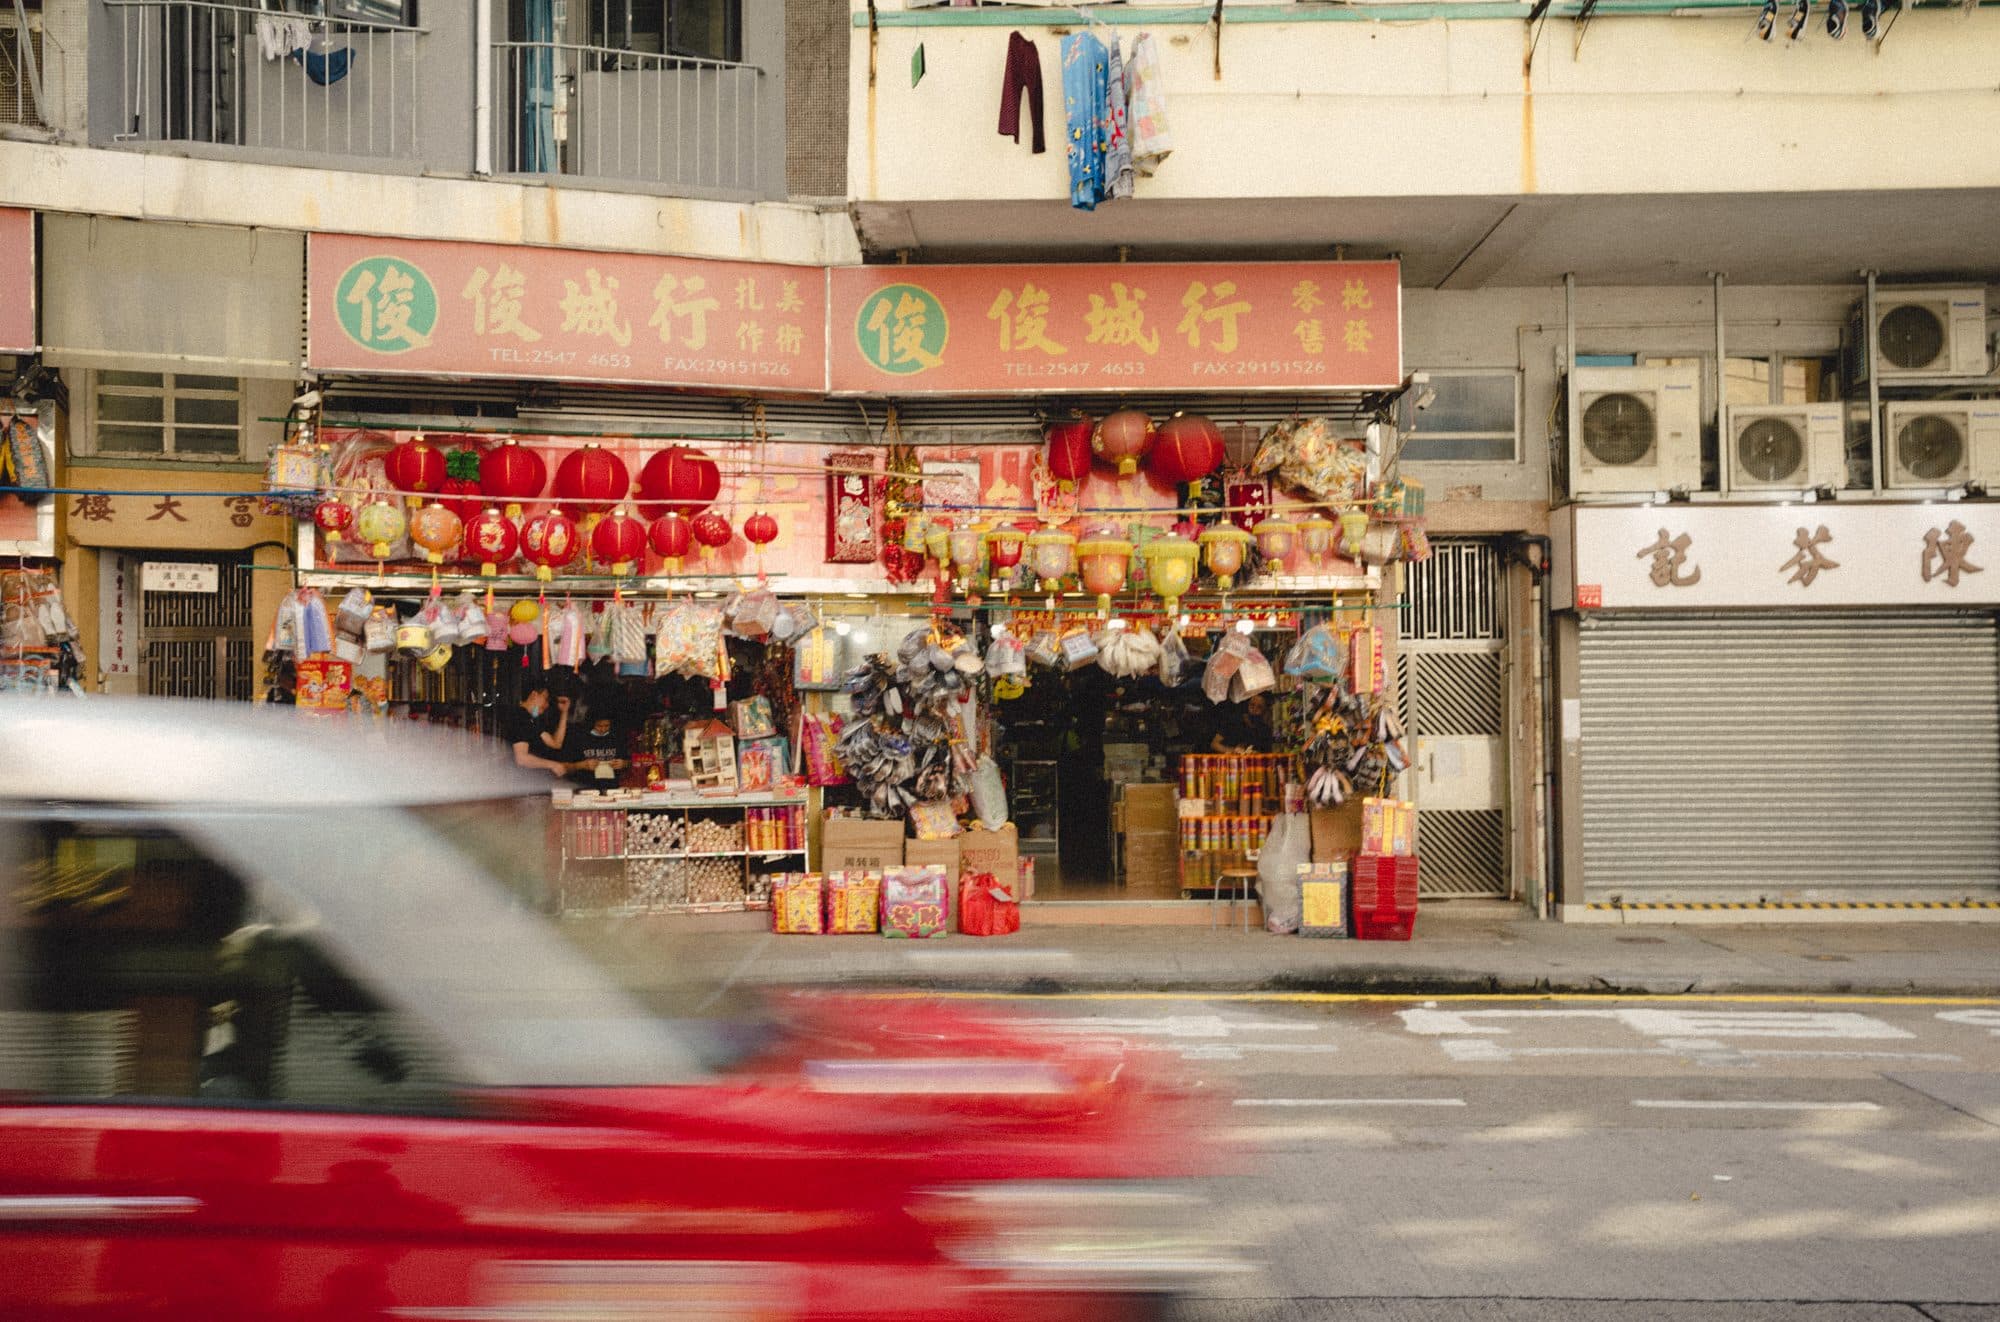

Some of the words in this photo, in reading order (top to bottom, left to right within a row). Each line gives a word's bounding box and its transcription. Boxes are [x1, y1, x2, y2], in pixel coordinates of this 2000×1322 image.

[346, 262, 434, 351] 俊
[461, 261, 721, 352] 俊城行
[866, 292, 945, 371] 俊
[987, 281, 1252, 356] 俊城行
[1101, 361, 1146, 376] 4653
